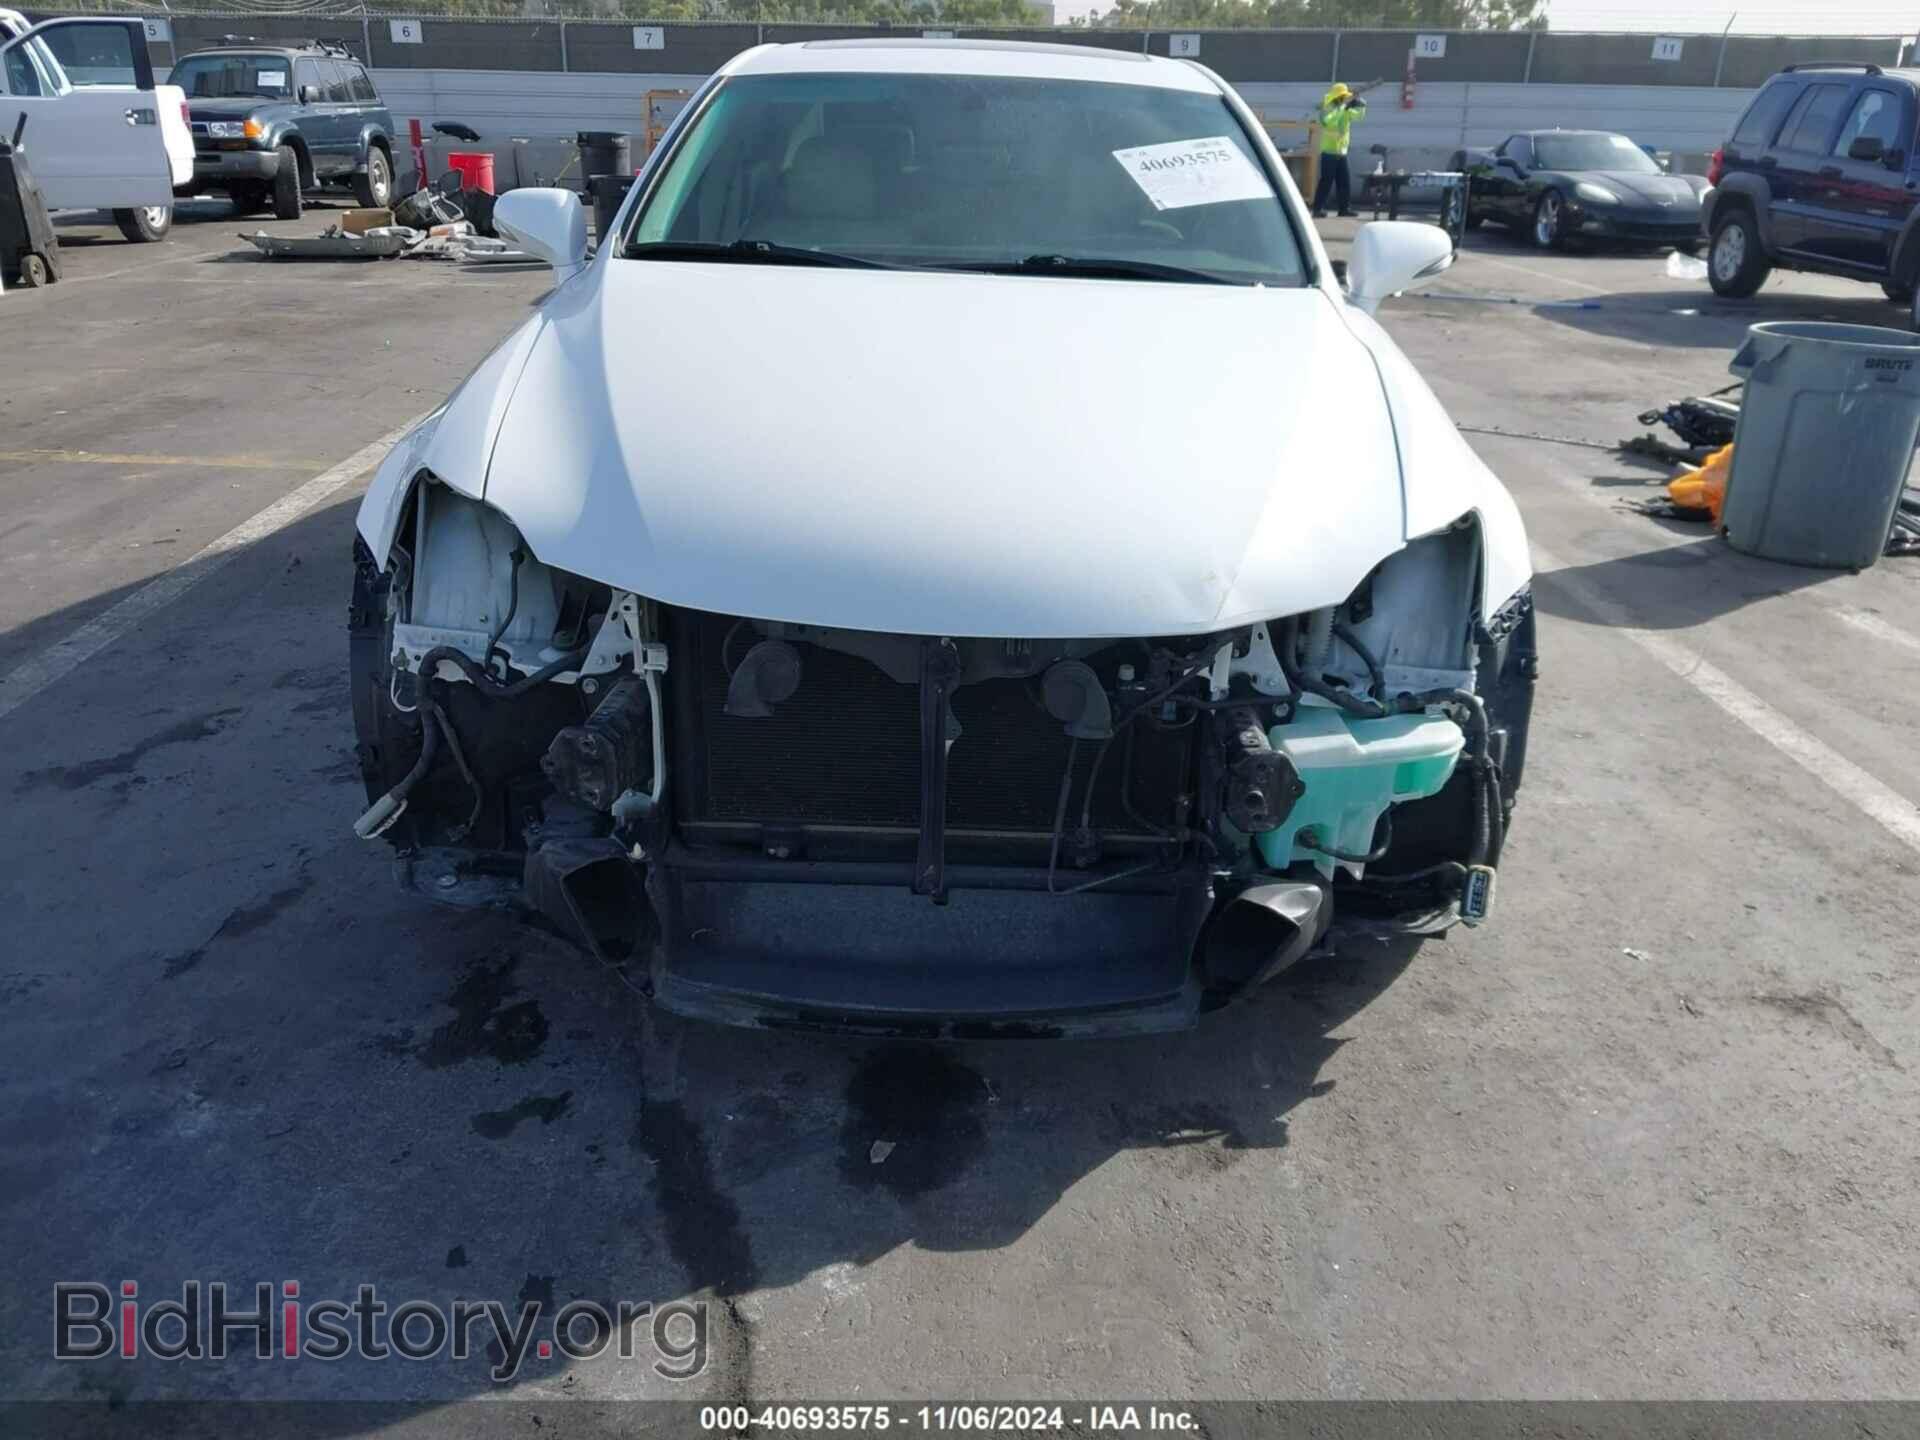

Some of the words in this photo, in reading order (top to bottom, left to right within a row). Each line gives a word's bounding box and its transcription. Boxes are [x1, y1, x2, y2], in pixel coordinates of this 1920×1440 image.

[147, 24, 157, 37] 5
[402, 25, 411, 38] 6
[643, 31, 653, 44] 7
[1181, 39, 1189, 51] 9
[1423, 39, 1439, 52] 10
[1662, 42, 1676, 56] 11
[1139, 149, 1233, 173] 40693575
